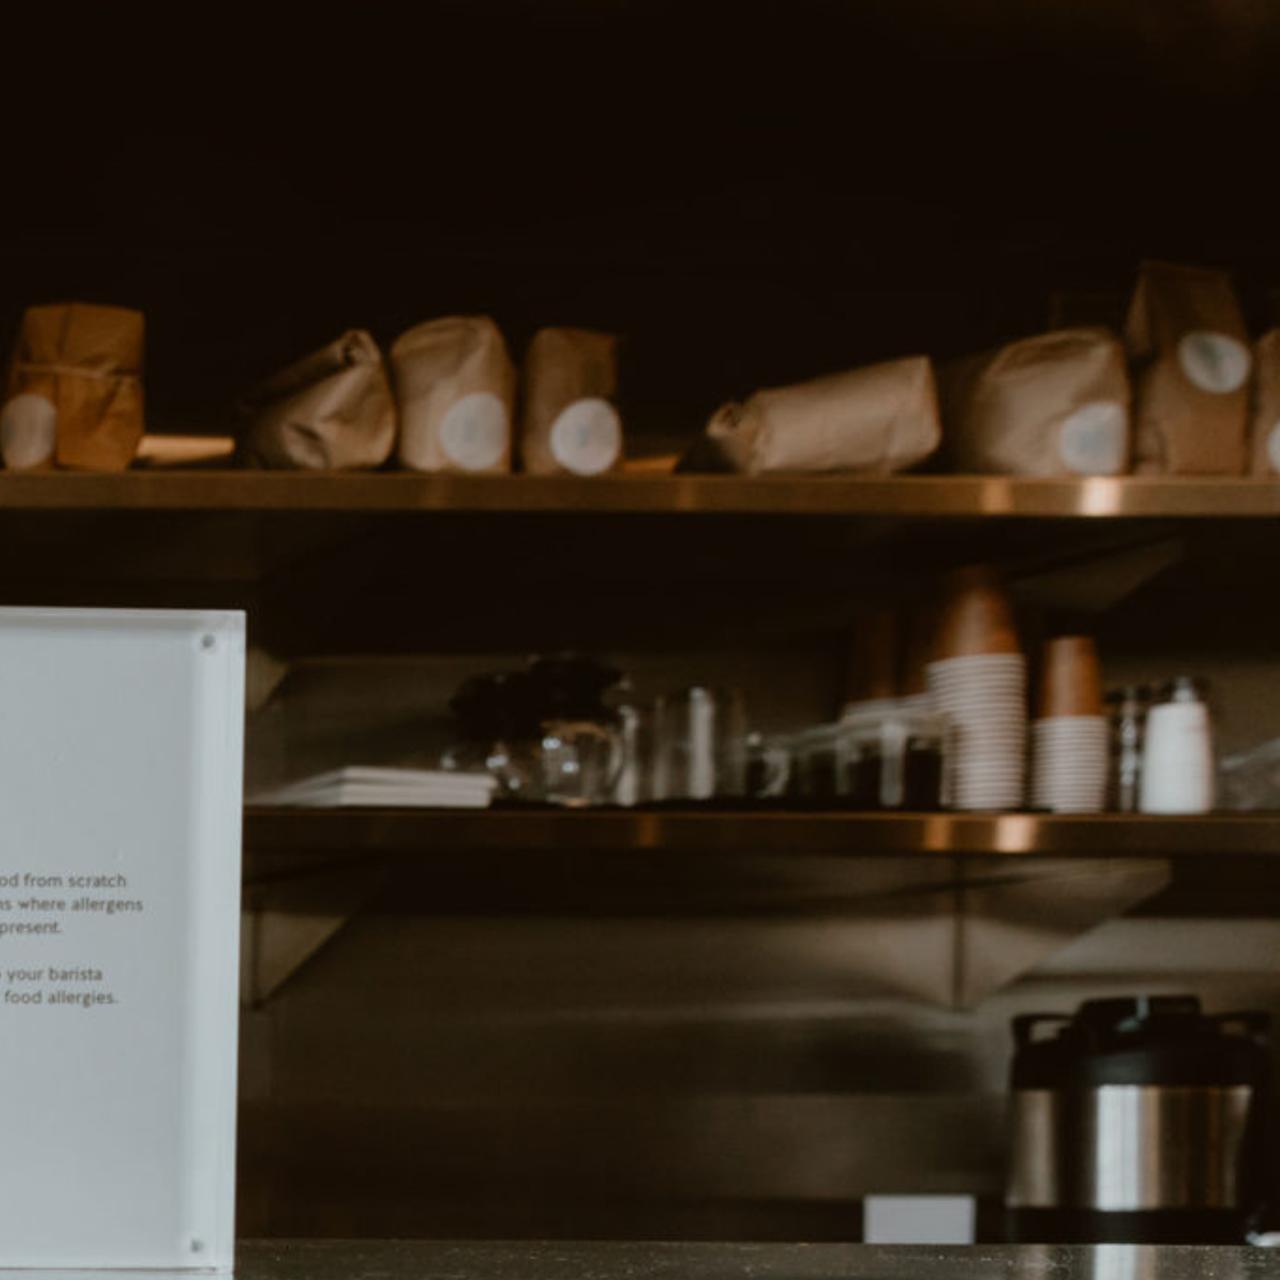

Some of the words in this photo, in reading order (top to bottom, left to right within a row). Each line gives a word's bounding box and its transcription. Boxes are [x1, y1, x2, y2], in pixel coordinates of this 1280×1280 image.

[24, 872, 62, 888] from
[69, 872, 126, 888] scratch
[18, 897, 66, 911] where
[71, 897, 143, 914] allergens
[0, 922, 62, 936] present.
[7, 970, 43, 983] your
[48, 967, 102, 981] barista
[5, 991, 42, 1005] food
[48, 991, 118, 1008] allergies.
